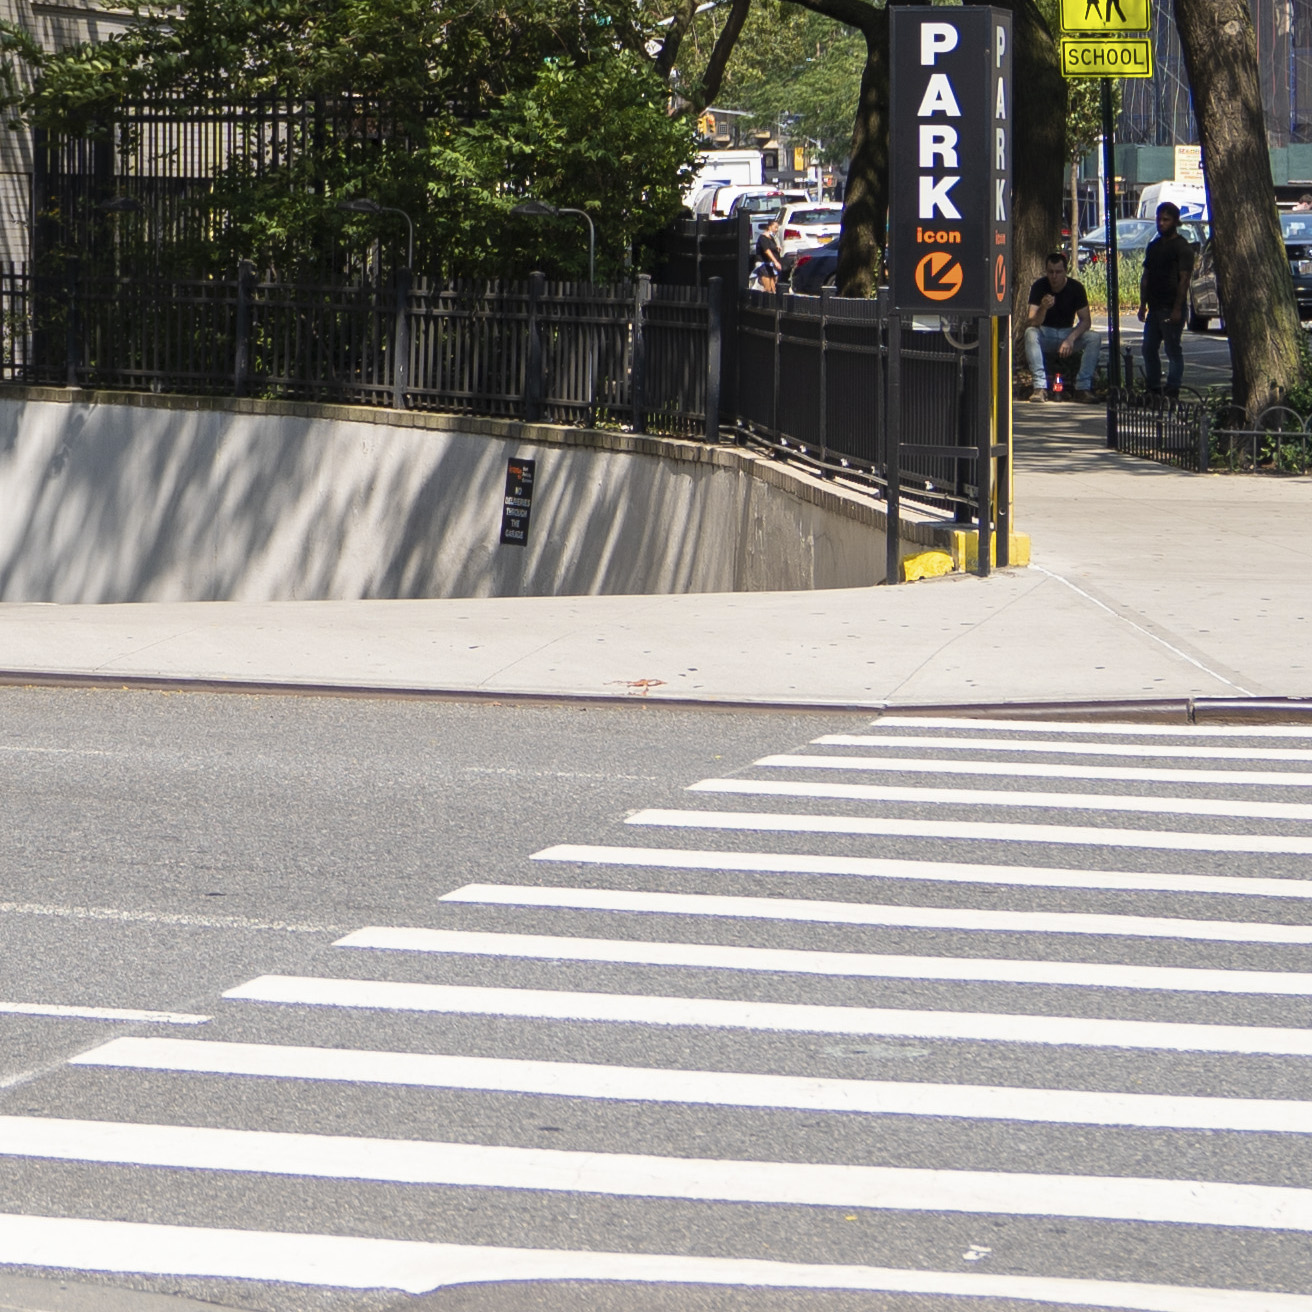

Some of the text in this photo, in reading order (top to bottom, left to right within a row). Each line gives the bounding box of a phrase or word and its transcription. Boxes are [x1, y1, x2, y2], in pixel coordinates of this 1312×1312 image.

[1068, 48, 1145, 66] SCHOOL
[917, 22, 962, 219] PARK
[995, 25, 1006, 221] PARK
[916, 227, 962, 244] icon
[514, 486, 523, 496] NO
[504, 496, 531, 507] DELIVERIES
[506, 507, 528, 518] THROUGH
